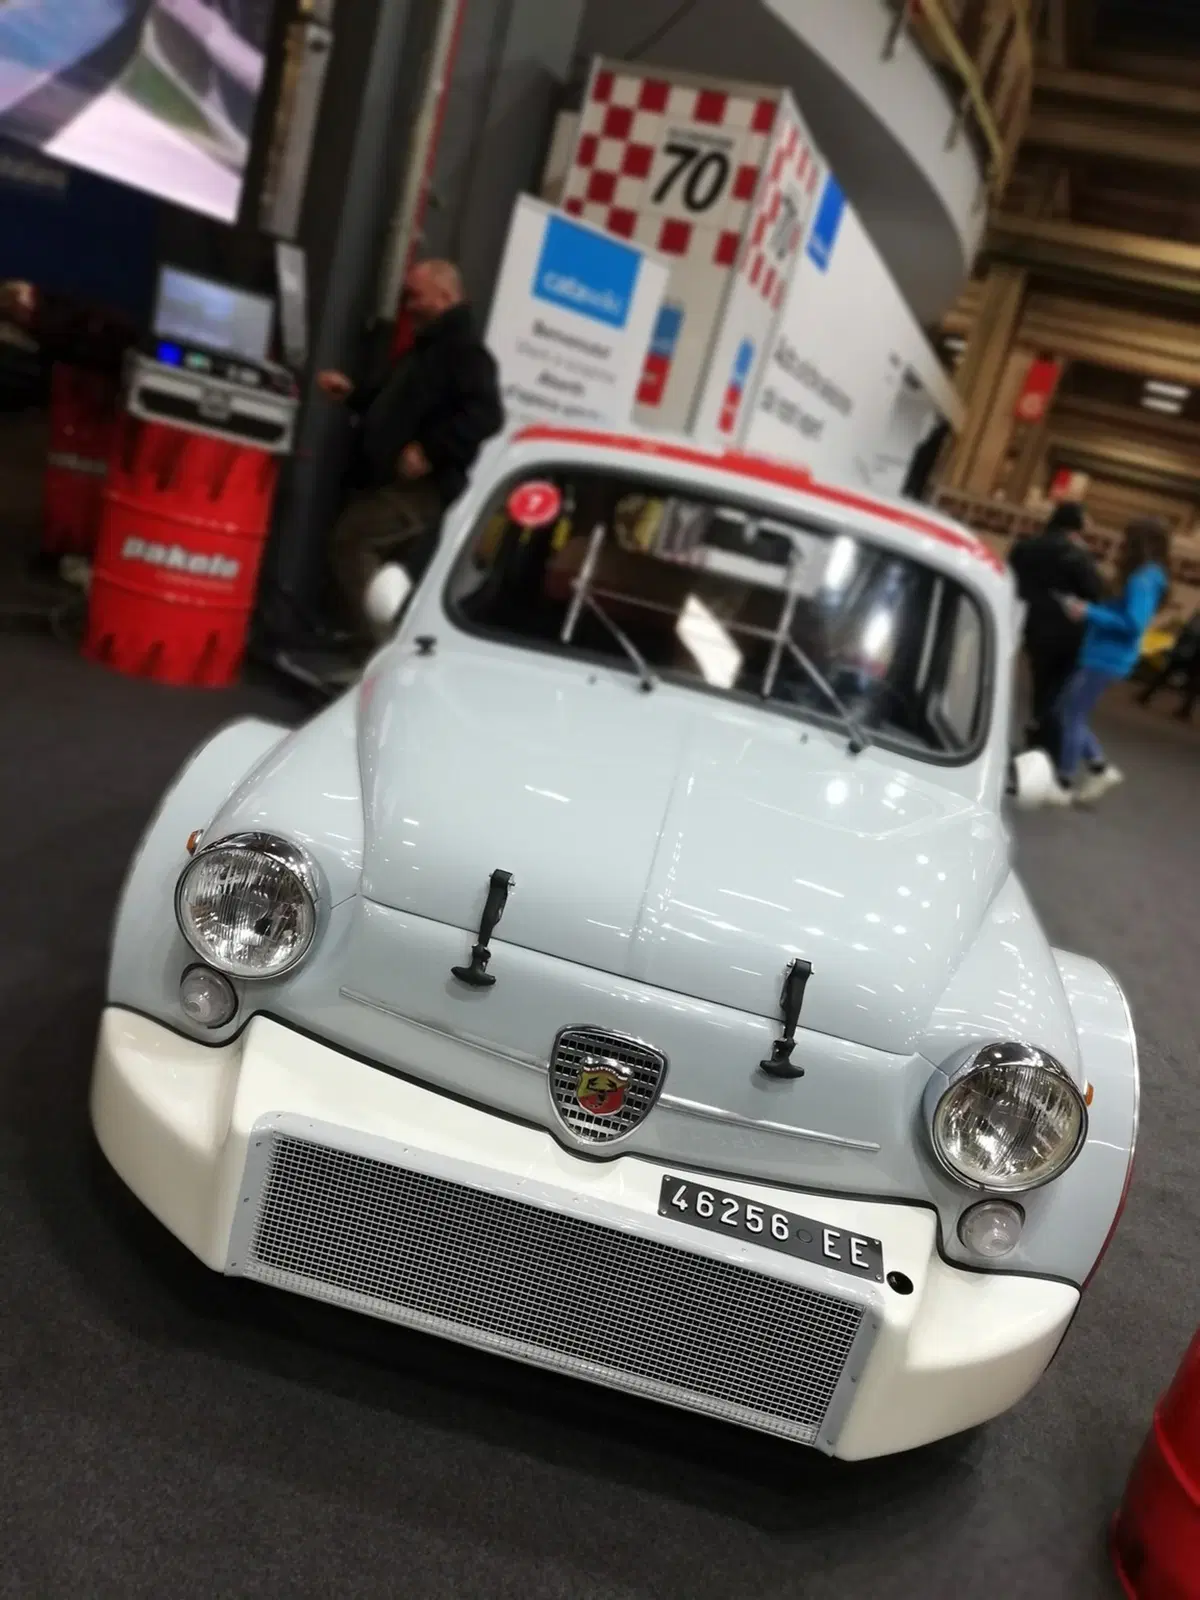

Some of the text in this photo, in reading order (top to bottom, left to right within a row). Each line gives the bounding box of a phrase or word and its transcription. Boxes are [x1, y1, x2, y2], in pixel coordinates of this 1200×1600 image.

[650, 142, 731, 213] 70
[671, 1184, 870, 1269] 46256 EE
